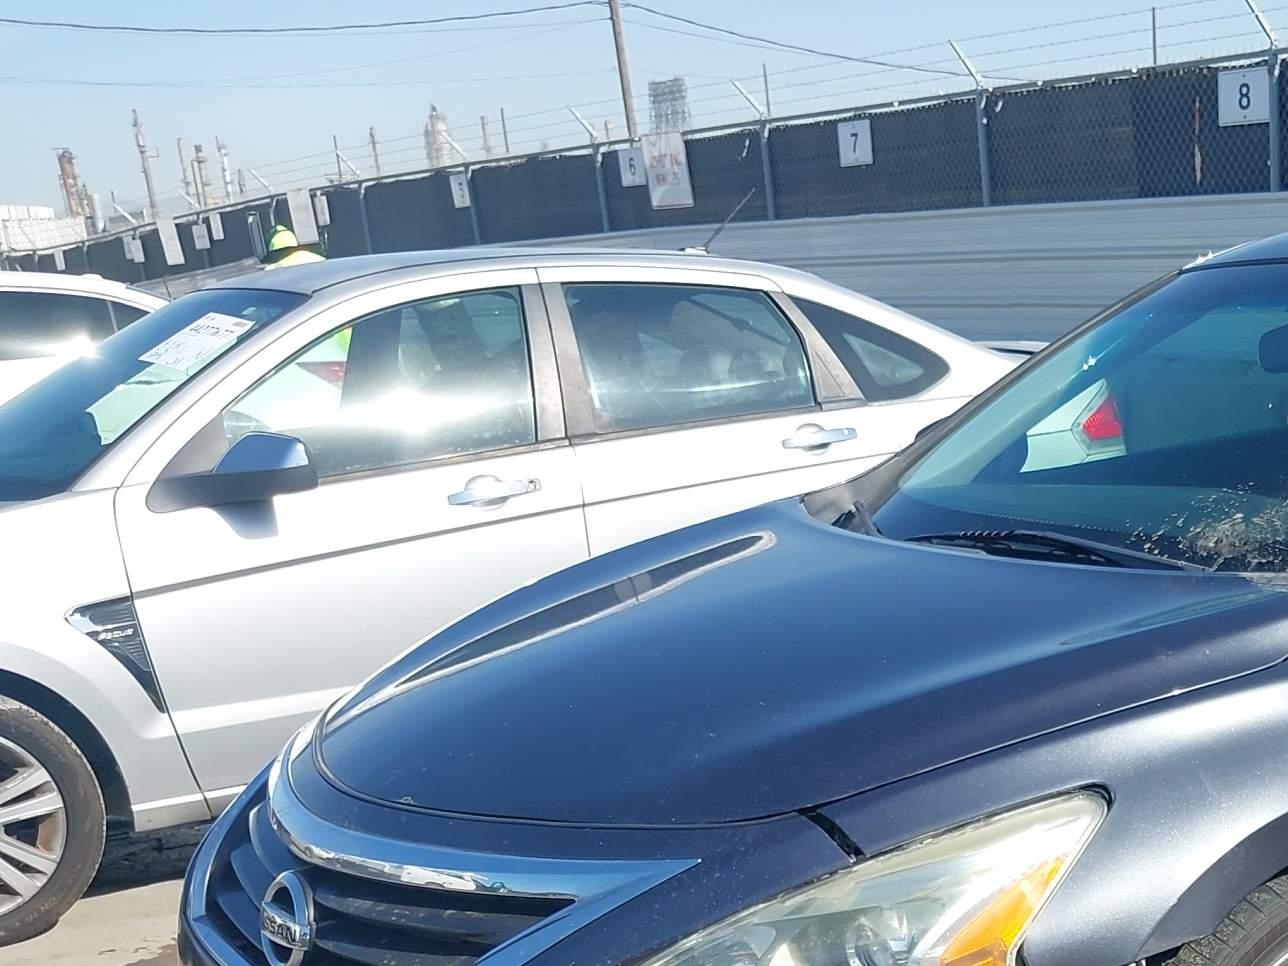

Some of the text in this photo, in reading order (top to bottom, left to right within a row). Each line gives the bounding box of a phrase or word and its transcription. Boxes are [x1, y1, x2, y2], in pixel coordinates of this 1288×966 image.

[1238, 82, 1251, 111] 8
[850, 132, 859, 154] 7
[628, 157, 637, 177] 6
[263, 915, 297, 943] SSAN
